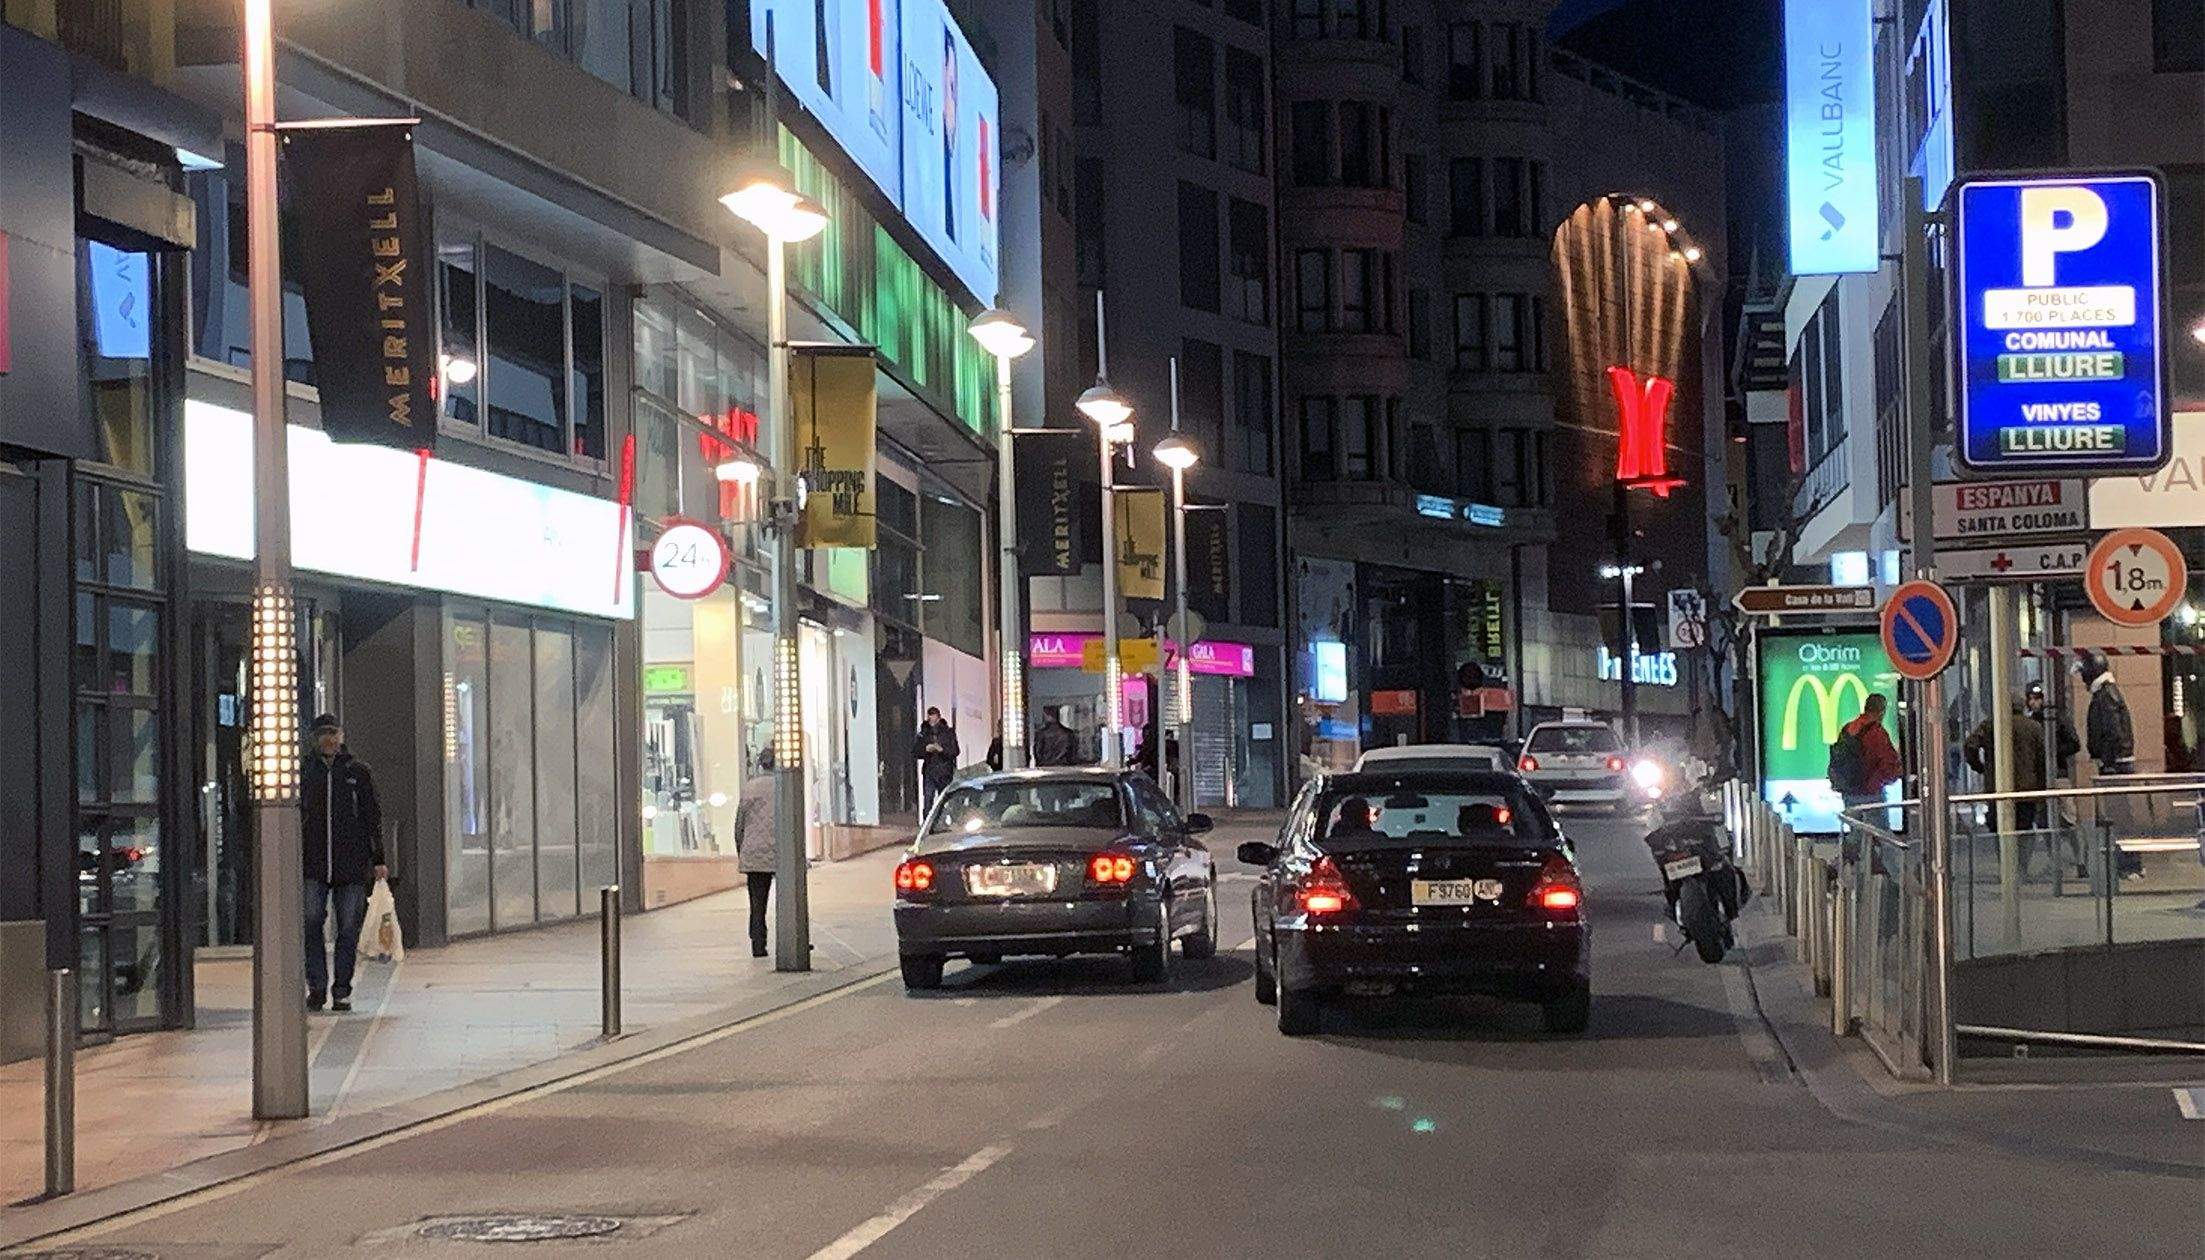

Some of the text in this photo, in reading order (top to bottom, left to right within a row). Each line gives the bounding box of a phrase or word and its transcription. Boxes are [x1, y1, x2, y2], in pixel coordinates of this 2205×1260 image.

[1820, 42, 1845, 192] VALLBANC
[2021, 186, 2108, 287] P
[367, 187, 412, 427] MERITXELL
[2027, 293, 2089, 306] PUBLIC
[2049, 309, 2116, 321] PLACES
[2005, 330, 2115, 350] COMUNAL
[2008, 354, 2114, 378] LLIURE
[2021, 402, 2102, 421] VINYES
[2008, 427, 2114, 450] LLIURE
[1963, 484, 2054, 510] ESPANYA
[1958, 512, 2080, 533] SANTA COLOMA
[1030, 638, 1066, 653] ALA
[1799, 643, 1861, 662] Obrim
